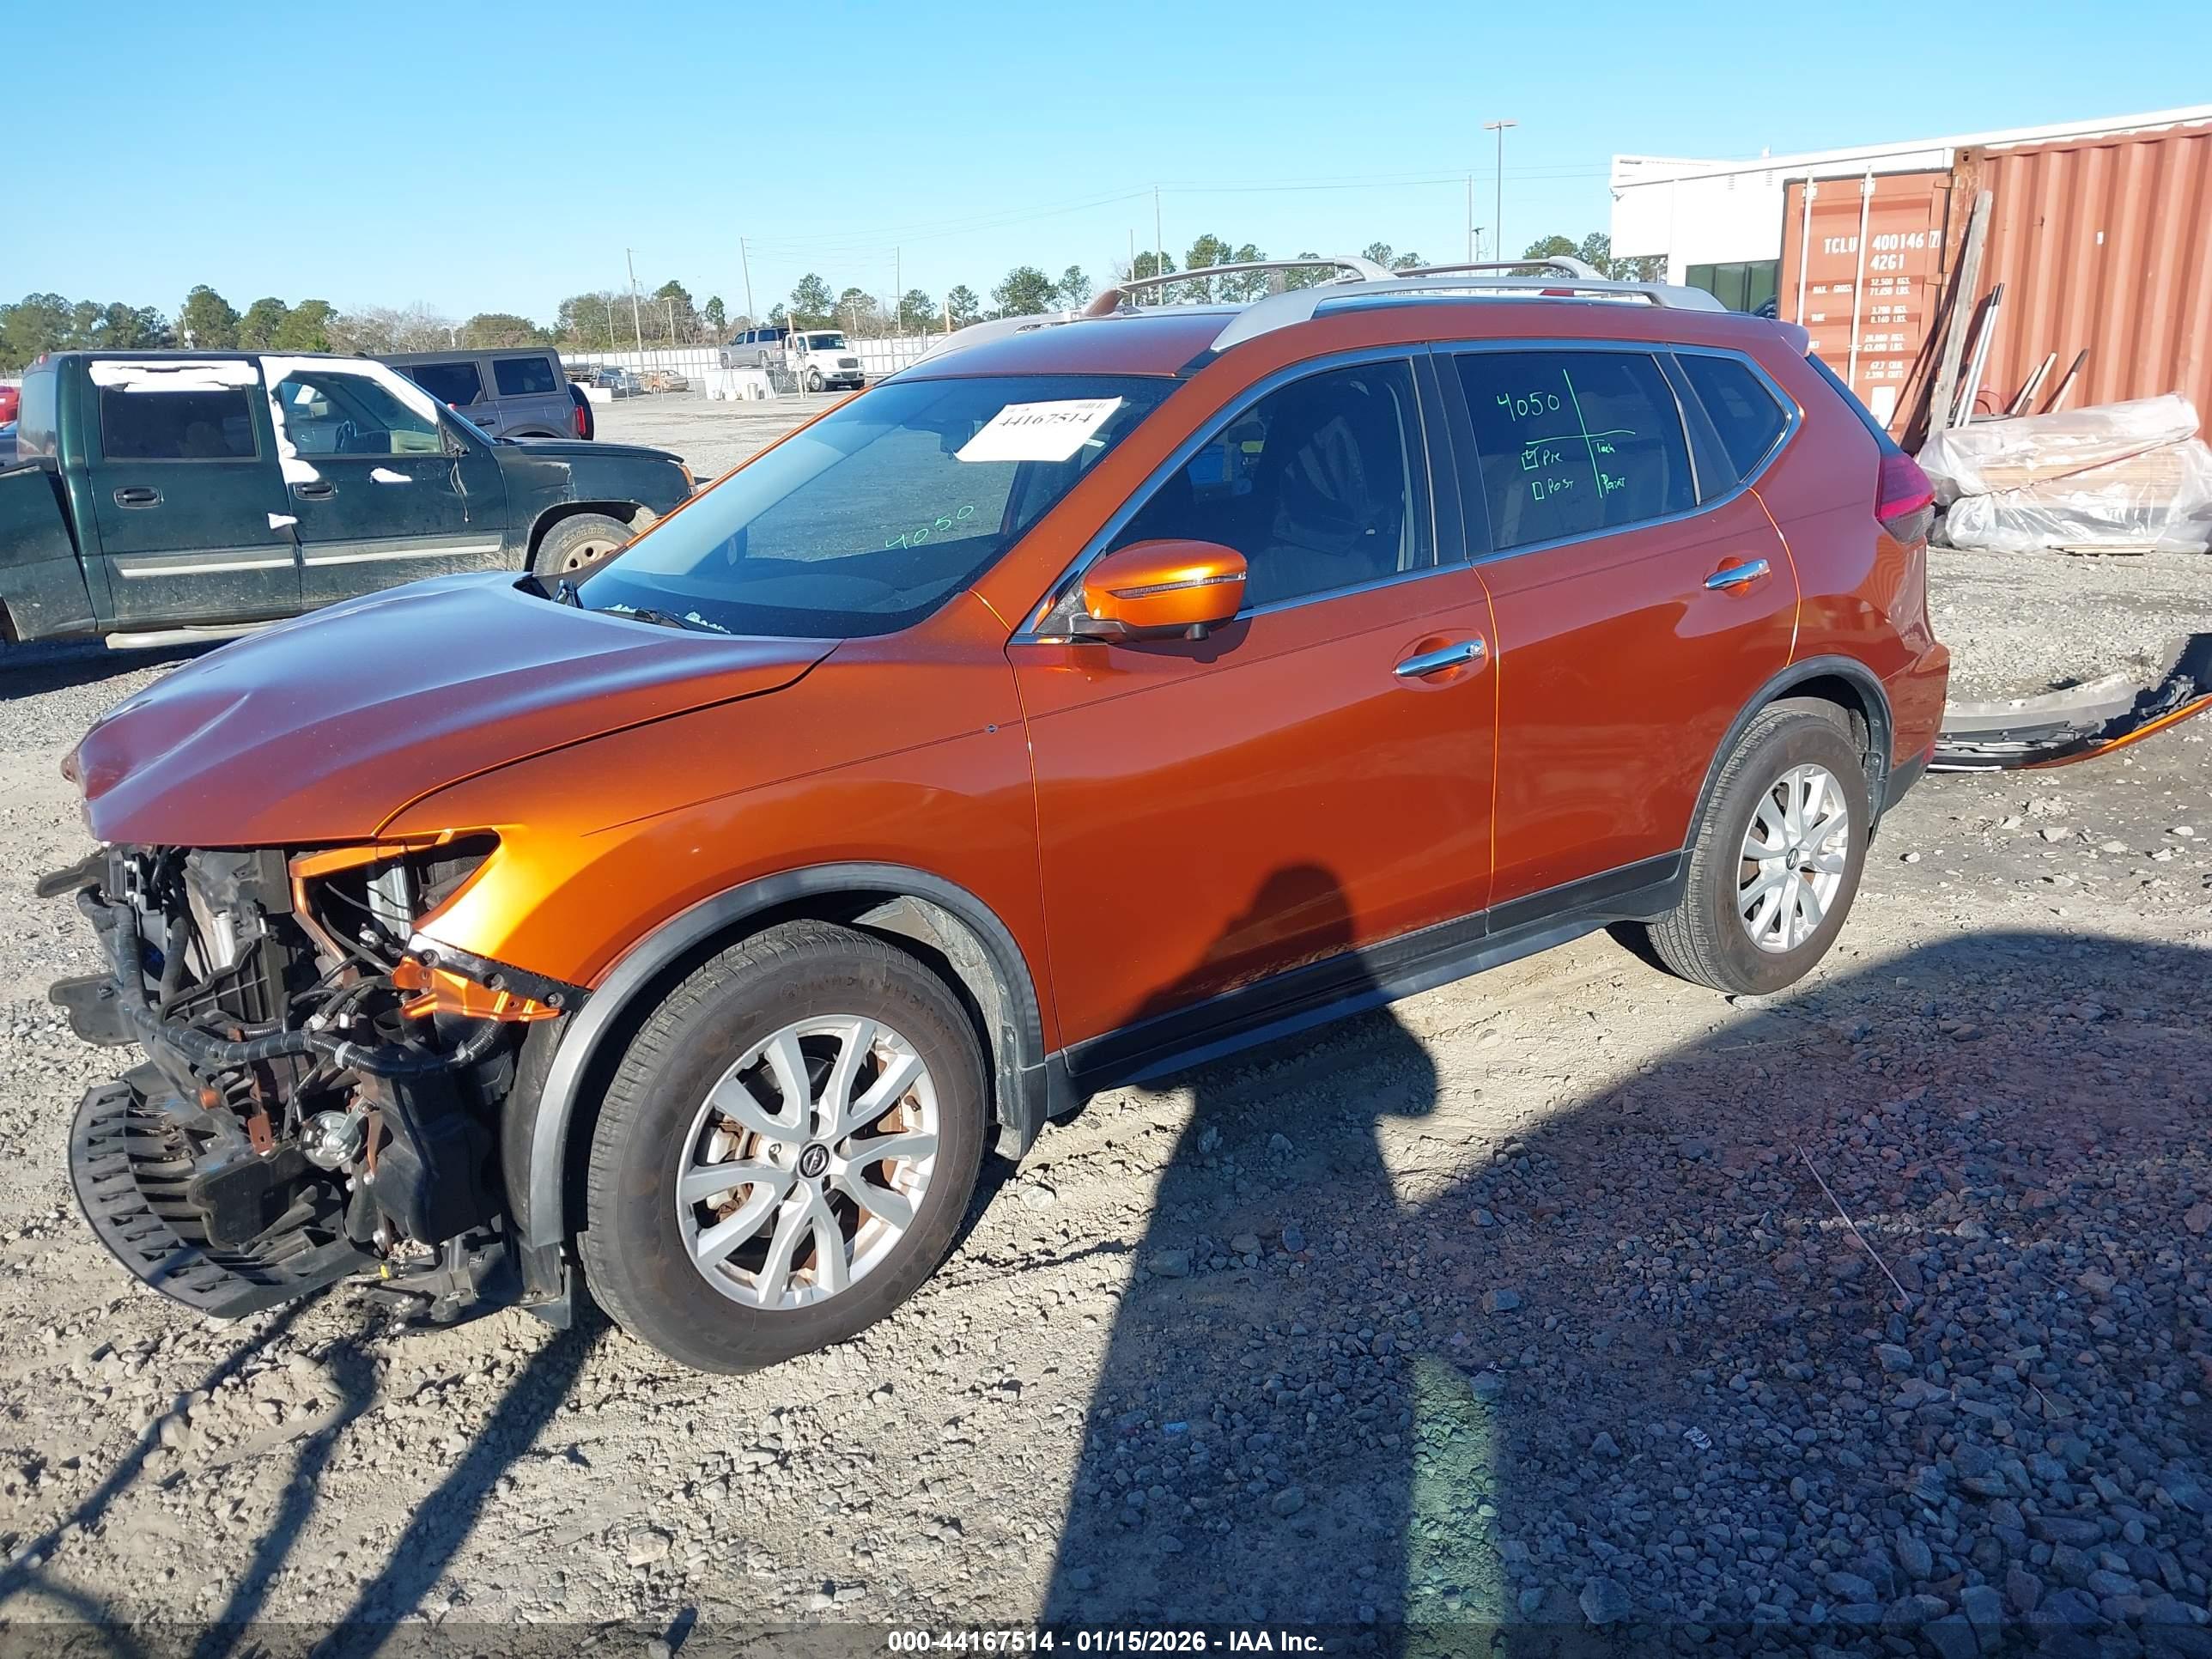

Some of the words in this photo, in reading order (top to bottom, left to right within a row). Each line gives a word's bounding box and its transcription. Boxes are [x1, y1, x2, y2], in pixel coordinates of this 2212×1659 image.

[1825, 237, 1857, 254] TCLU
[1872, 233, 1924, 251] 400146
[1870, 254, 1905, 270] 42G1
[1497, 391, 1560, 422] 4050
[999, 412, 1095, 427] 44167514
[885, 505, 975, 550] 4050
